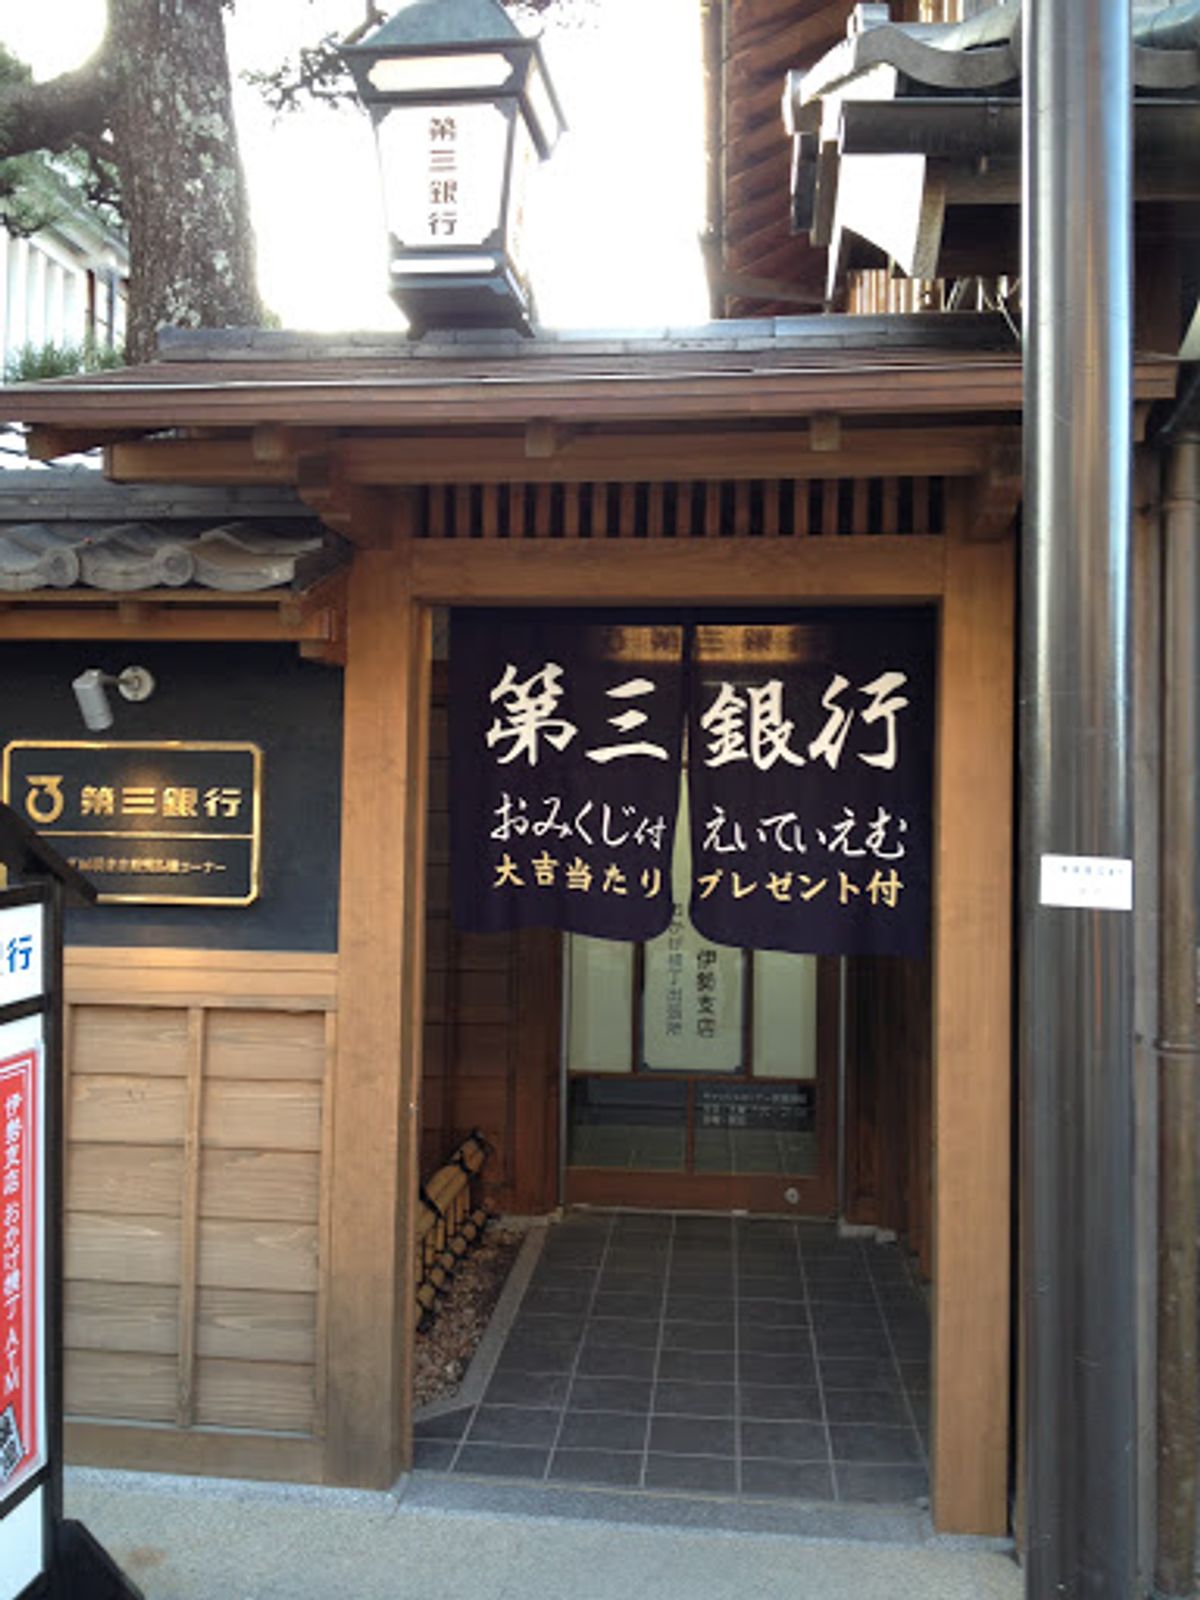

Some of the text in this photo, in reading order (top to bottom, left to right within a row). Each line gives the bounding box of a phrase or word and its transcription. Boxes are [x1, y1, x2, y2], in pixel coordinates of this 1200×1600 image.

[428, 116, 457, 235] 第三銀行
[485, 661, 908, 770] 第三銀行
[80, 785, 242, 818] 第三銀行
[490, 792, 907, 858] おみくじ付 えいていえむ
[494, 852, 903, 906] 大吉当たり プレゼント付
